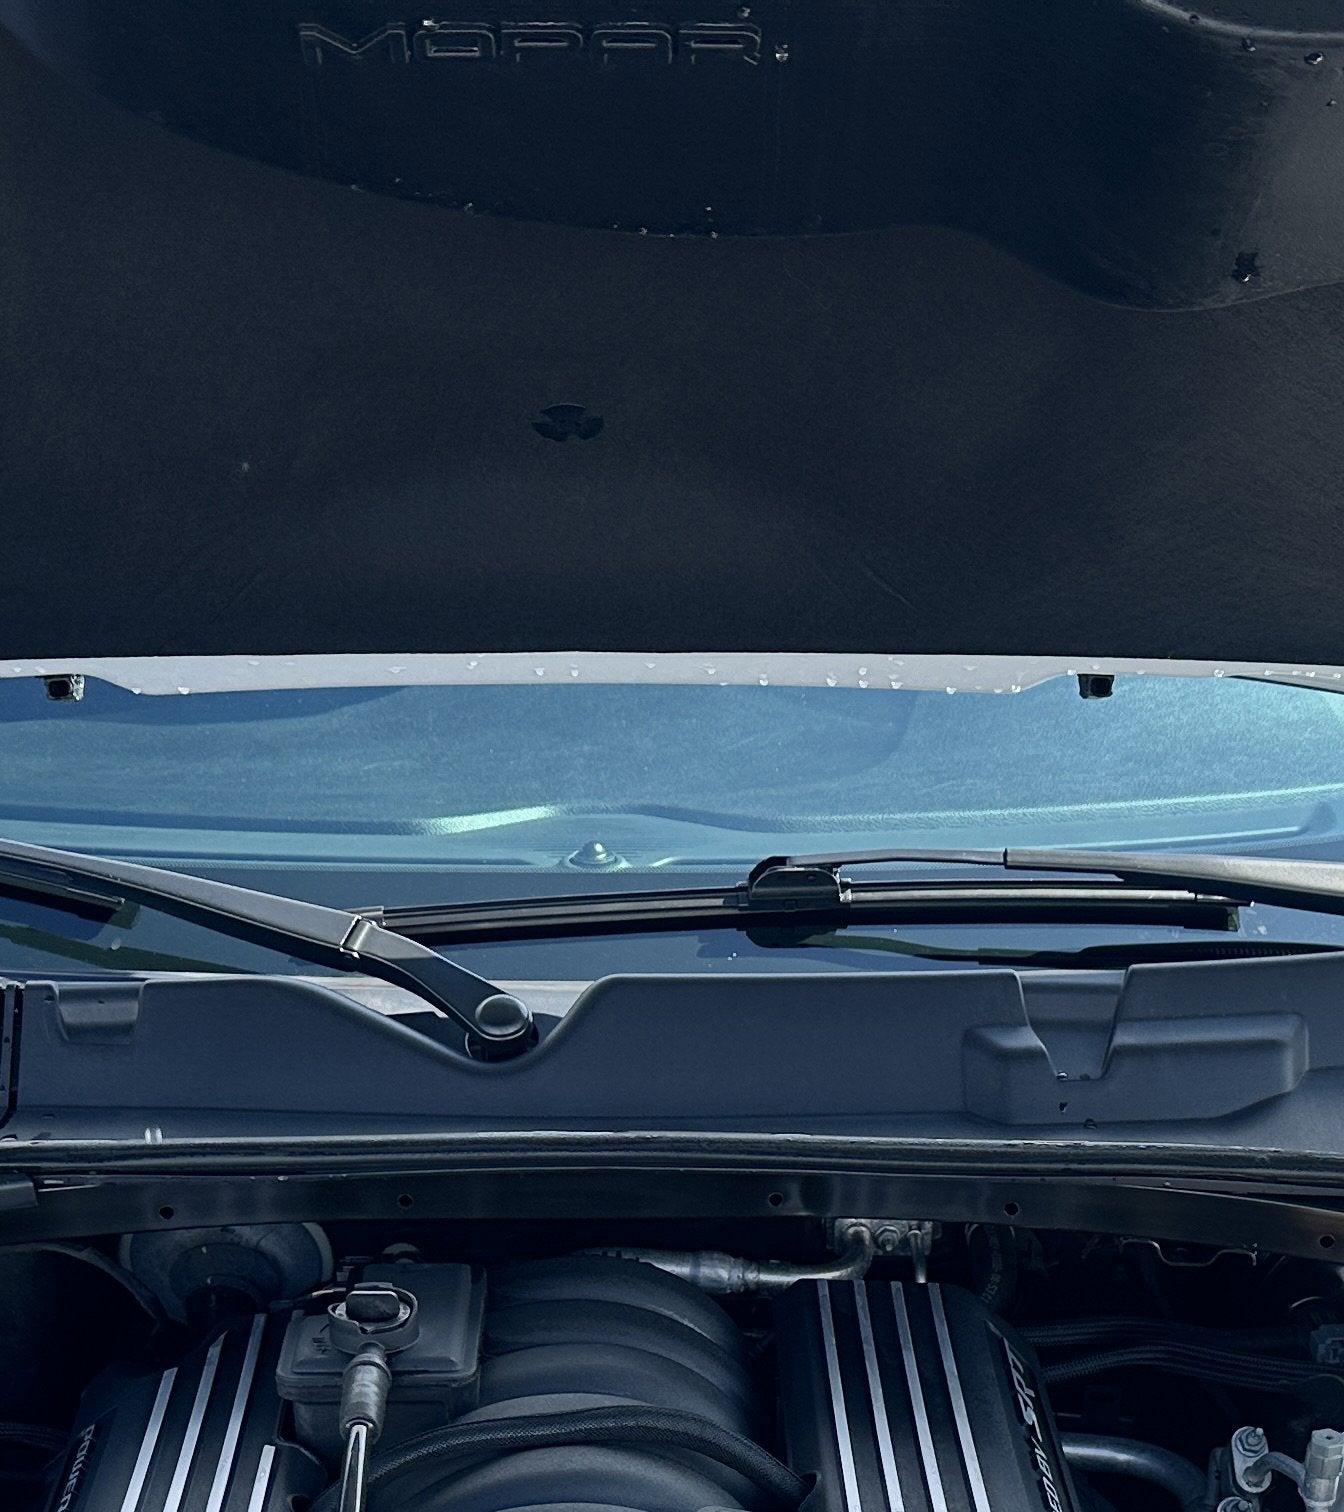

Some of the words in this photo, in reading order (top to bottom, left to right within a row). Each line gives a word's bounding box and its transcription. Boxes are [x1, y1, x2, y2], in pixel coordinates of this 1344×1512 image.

[297, 21, 763, 66] MOPAR
[1005, 1338, 1043, 1443] SRT
[1031, 1436, 1053, 1481] BY
